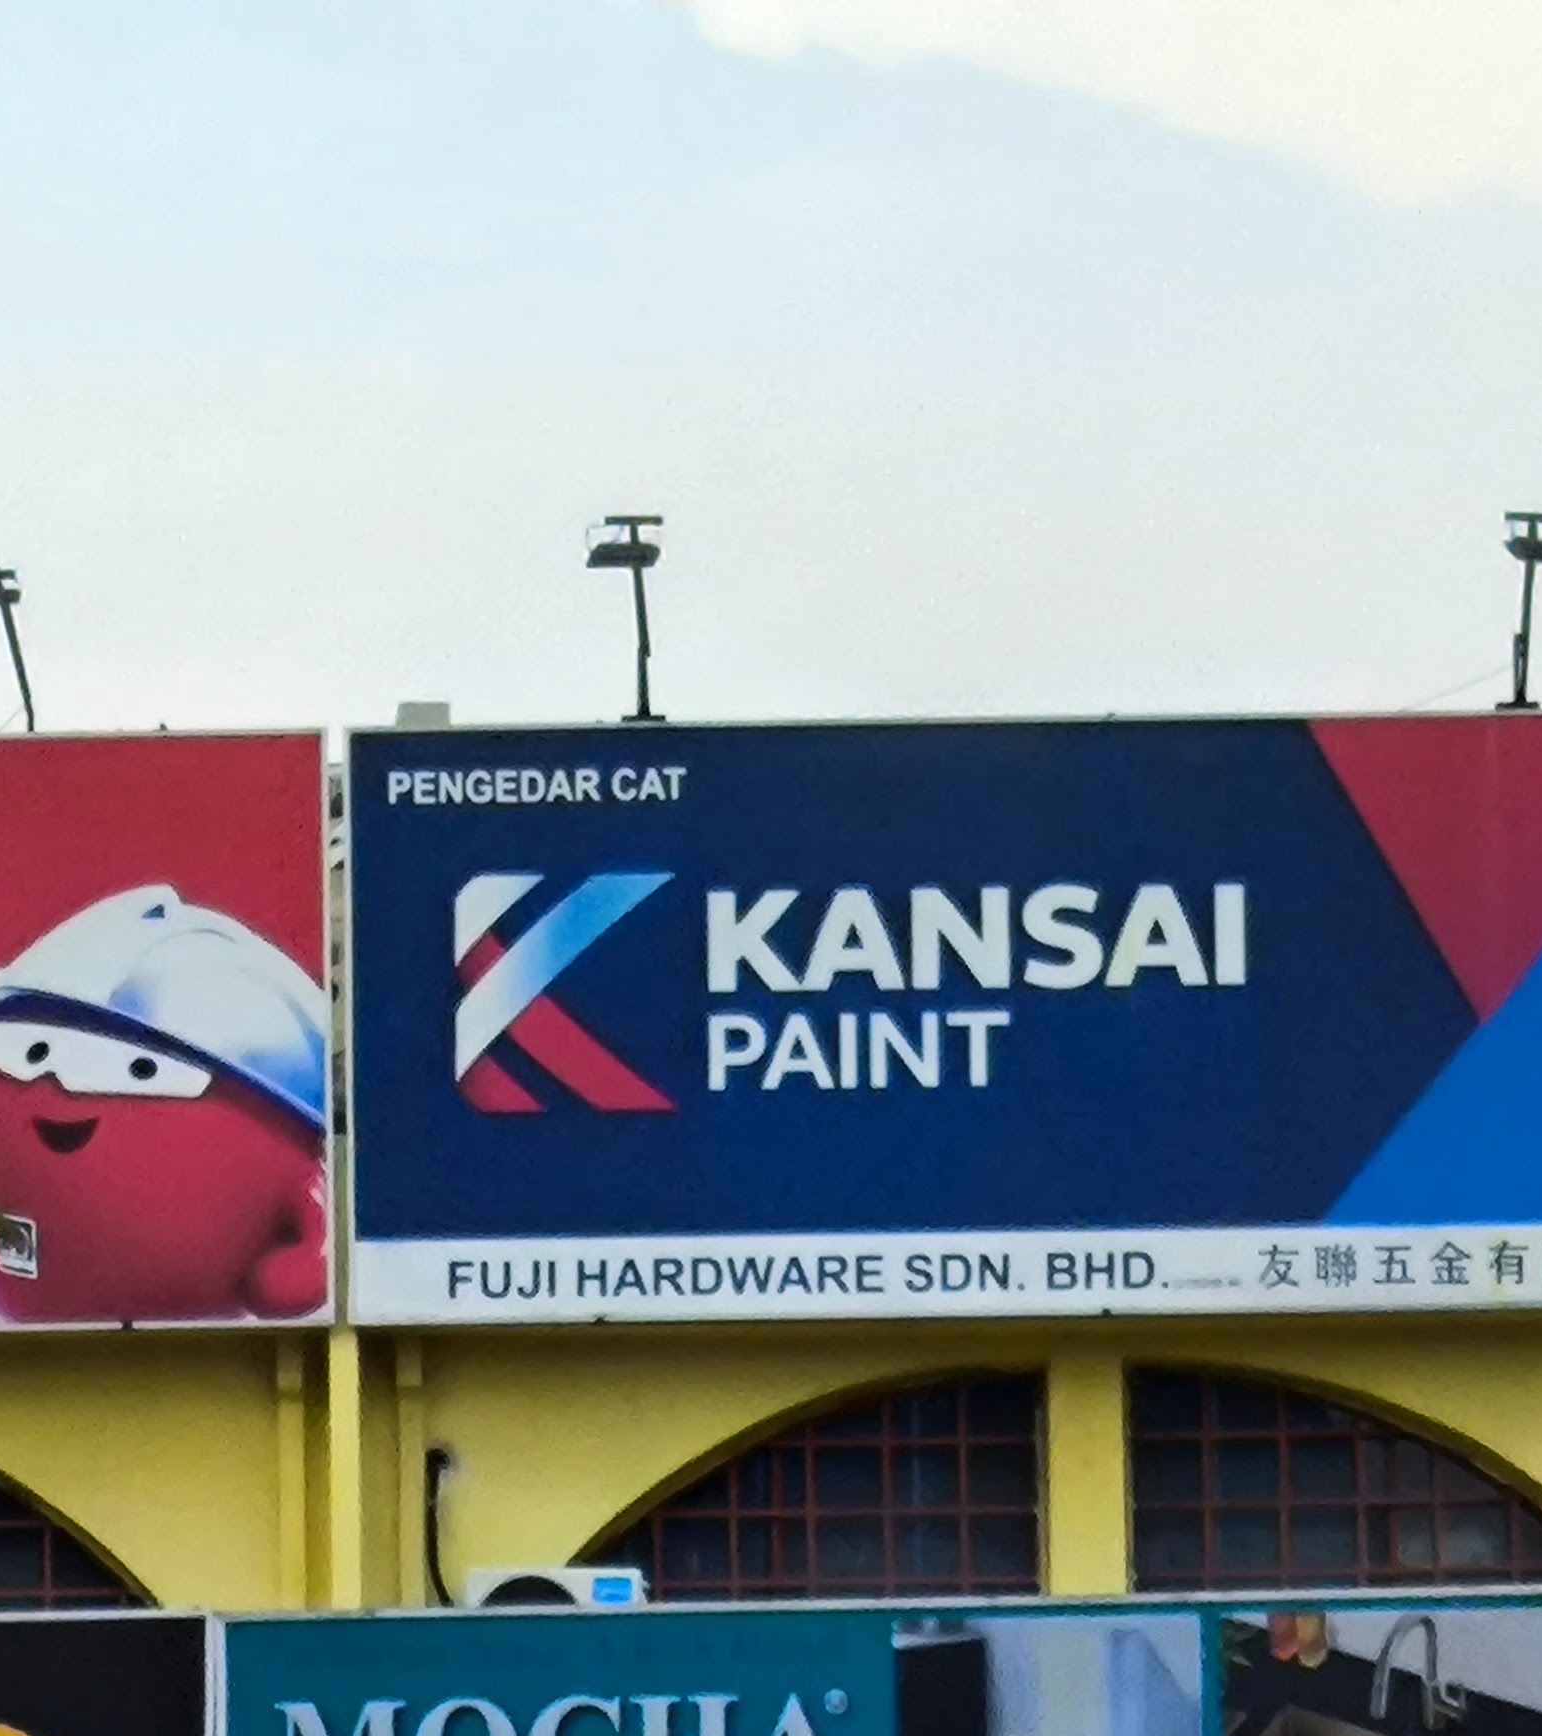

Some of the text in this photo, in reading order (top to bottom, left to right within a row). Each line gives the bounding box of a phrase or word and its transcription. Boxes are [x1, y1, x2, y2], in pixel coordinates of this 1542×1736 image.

[387, 767, 687, 806] PENGEDAR CAT
[706, 880, 1248, 993] KANSAI
[706, 1010, 1011, 1091] PAINT
[447, 1260, 558, 1300] FUJI
[576, 1254, 884, 1298] HARDWARE
[905, 1252, 1025, 1294] SDN.
[1047, 1247, 1170, 1291] BHD.
